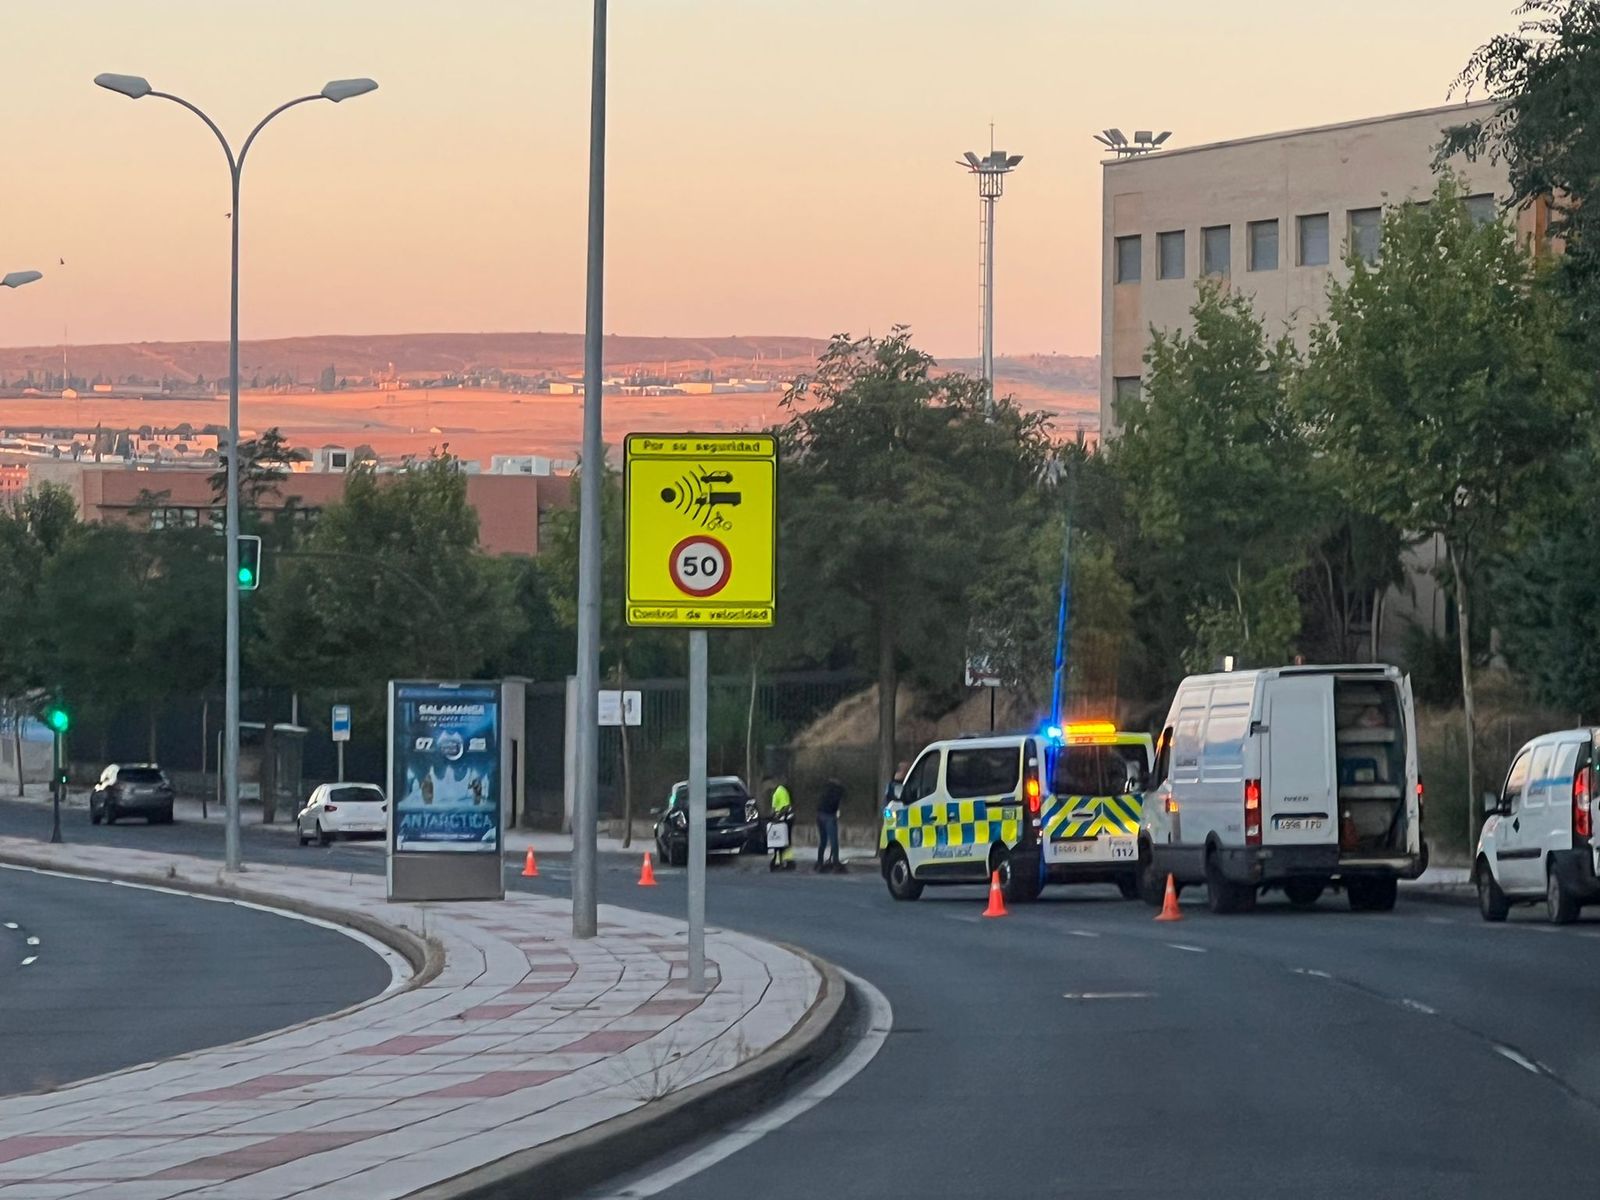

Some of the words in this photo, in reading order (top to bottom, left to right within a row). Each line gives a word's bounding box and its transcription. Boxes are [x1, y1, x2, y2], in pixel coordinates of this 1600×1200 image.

[643, 440, 664, 450] Por
[672, 442, 687, 450] su
[695, 440, 760, 453] seguridad
[683, 556, 717, 577] 50
[632, 608, 678, 620] Control
[686, 609, 700, 620] de
[709, 608, 768, 620] velocidad
